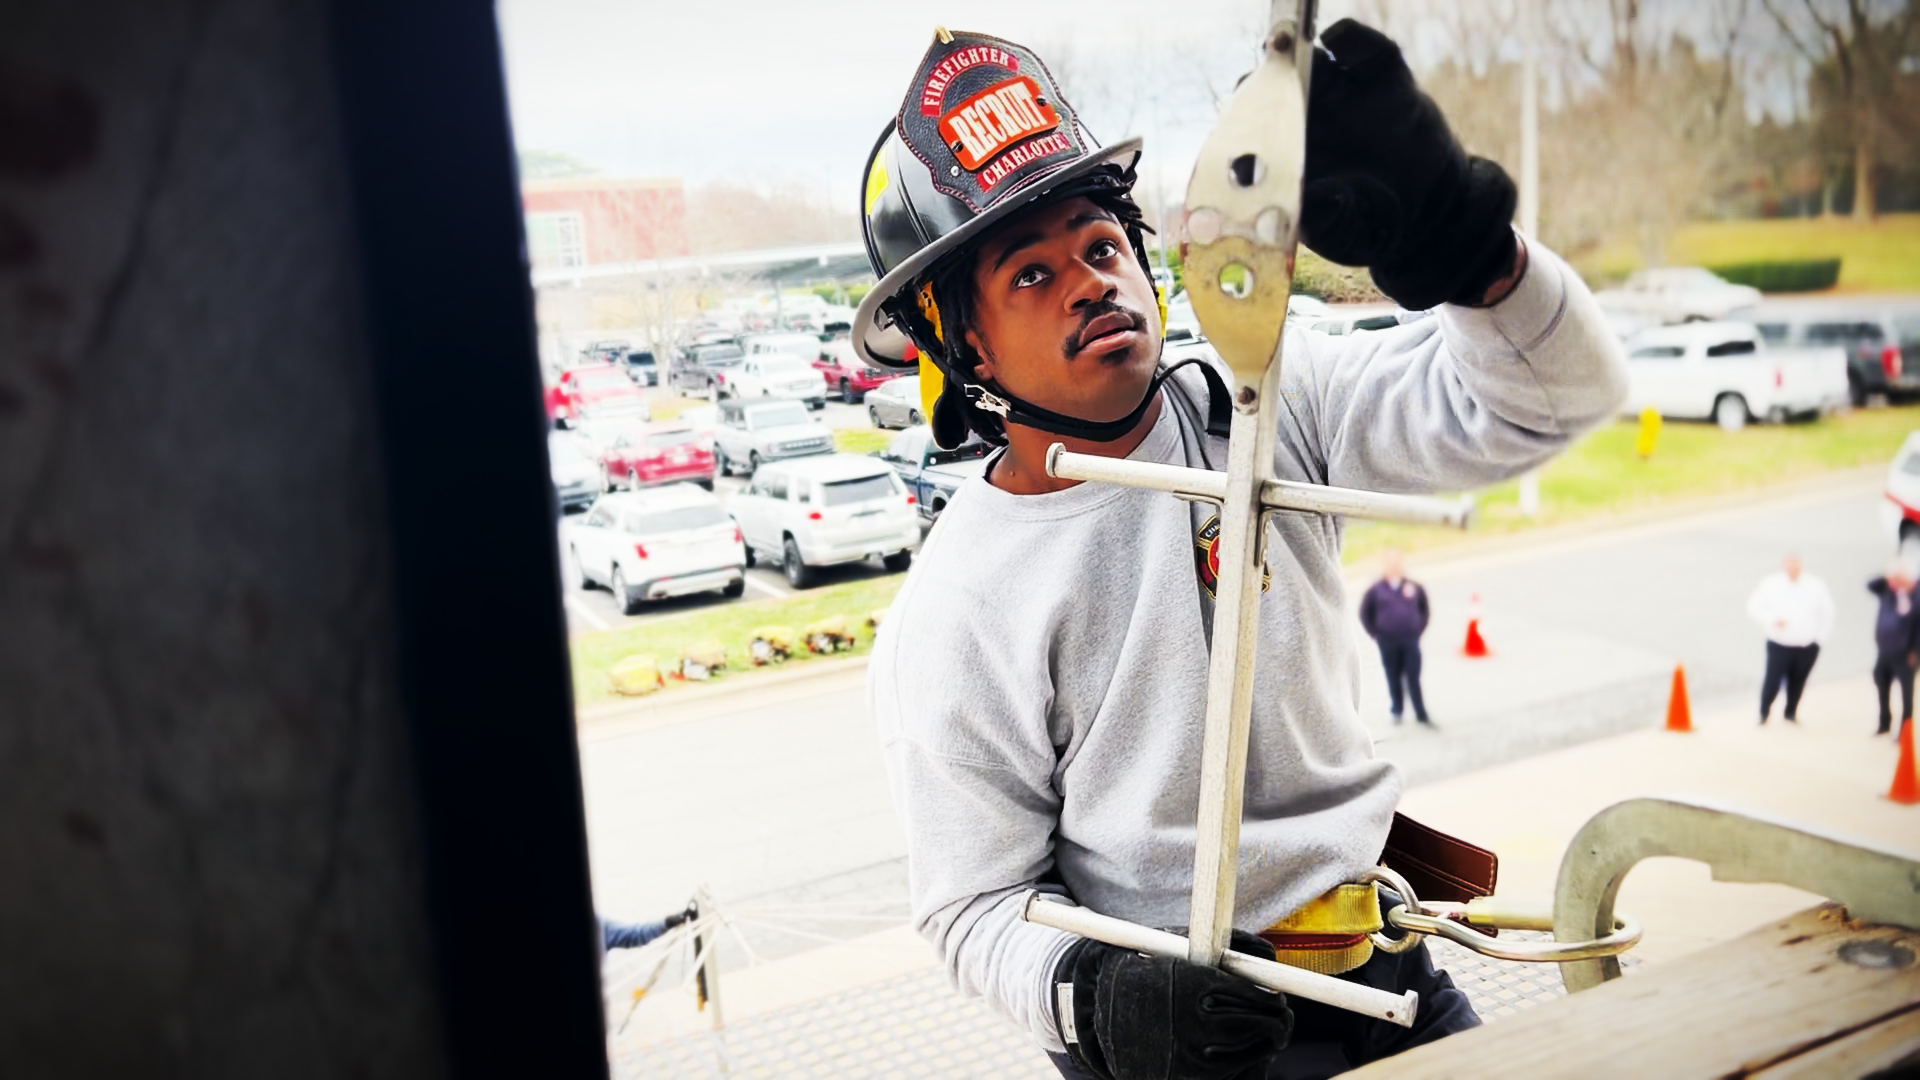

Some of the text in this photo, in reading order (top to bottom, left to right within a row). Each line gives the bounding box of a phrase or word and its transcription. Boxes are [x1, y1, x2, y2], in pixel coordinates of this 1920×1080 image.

[924, 47, 1010, 106] FIREFIGHTER
[948, 81, 1048, 162] RECRUIT
[982, 133, 1066, 186] CHARLOTTE
